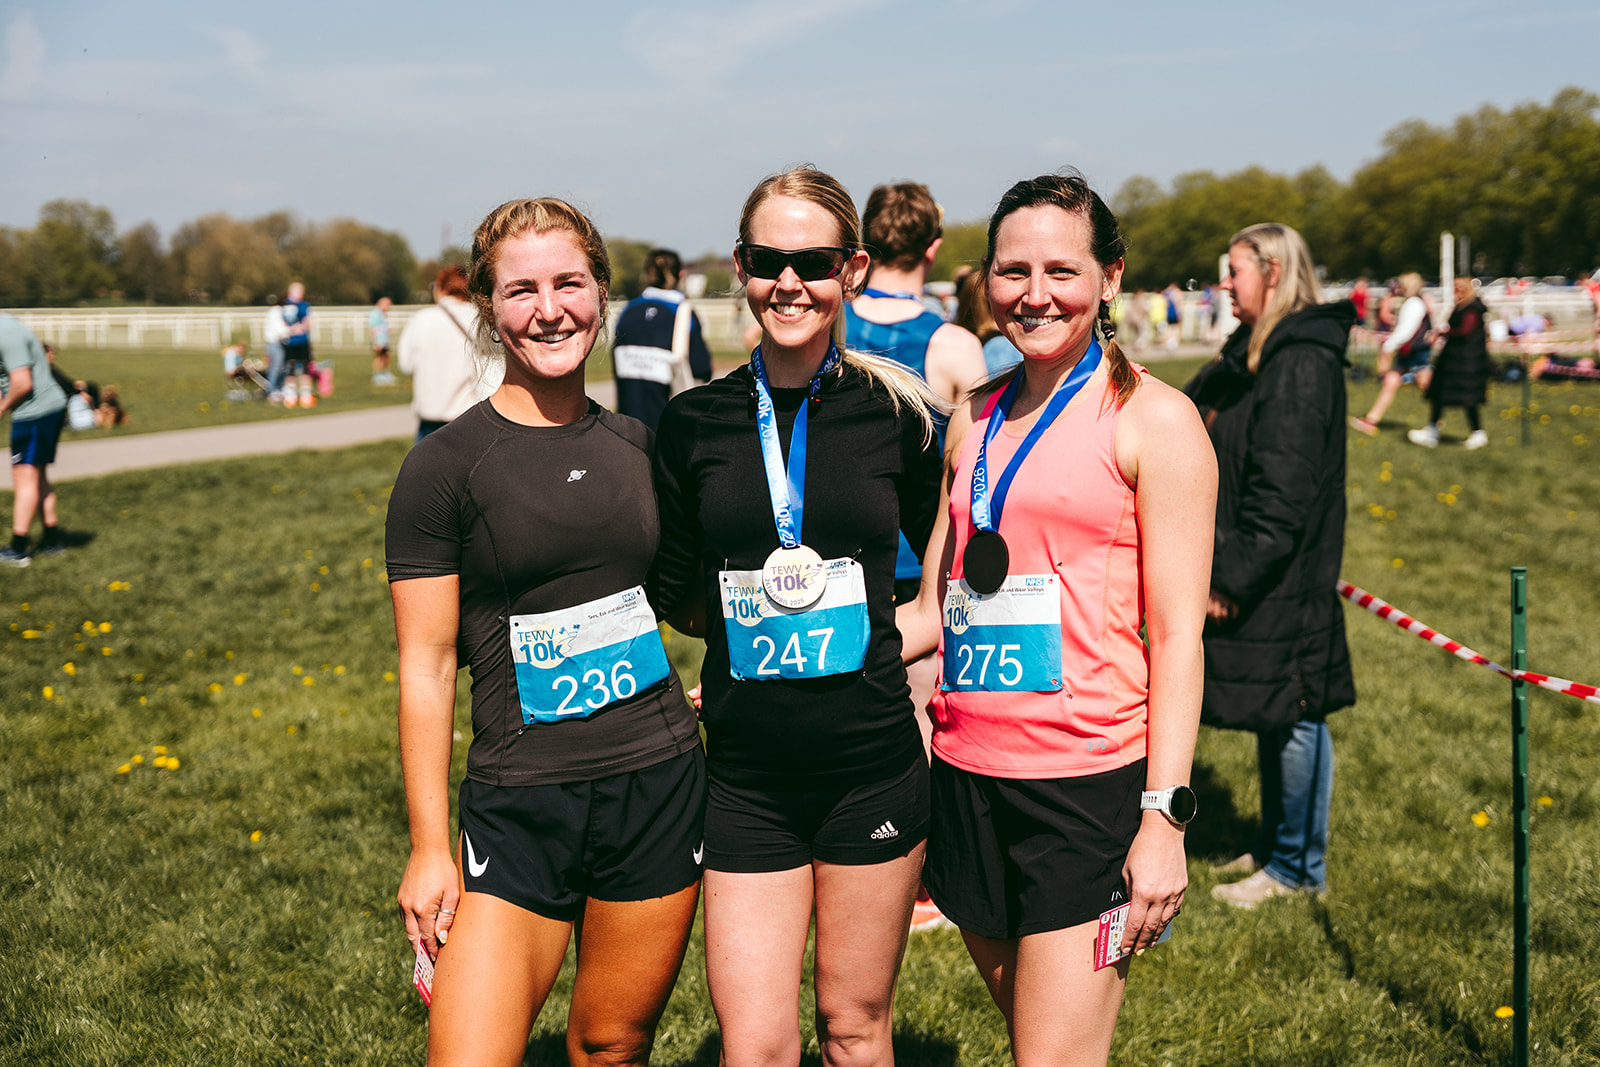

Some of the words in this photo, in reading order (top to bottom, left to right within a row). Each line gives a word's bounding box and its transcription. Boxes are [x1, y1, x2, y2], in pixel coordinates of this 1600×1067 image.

[973, 467, 986, 500] 2026
[777, 500, 791, 528] 10k
[770, 565, 802, 575] TEWV
[726, 586, 755, 597] TEWV
[772, 574, 808, 592] 10k
[1025, 577, 1044, 586] NHS
[727, 598, 762, 619] 10k
[772, 593, 788, 605] APRIL
[947, 606, 969, 627] 10k
[517, 628, 555, 643] TEWV
[519, 640, 565, 663] 10k
[752, 627, 834, 675] 247
[957, 644, 1023, 686] 275
[552, 660, 637, 716] 236
[870, 830, 899, 839] adidas
